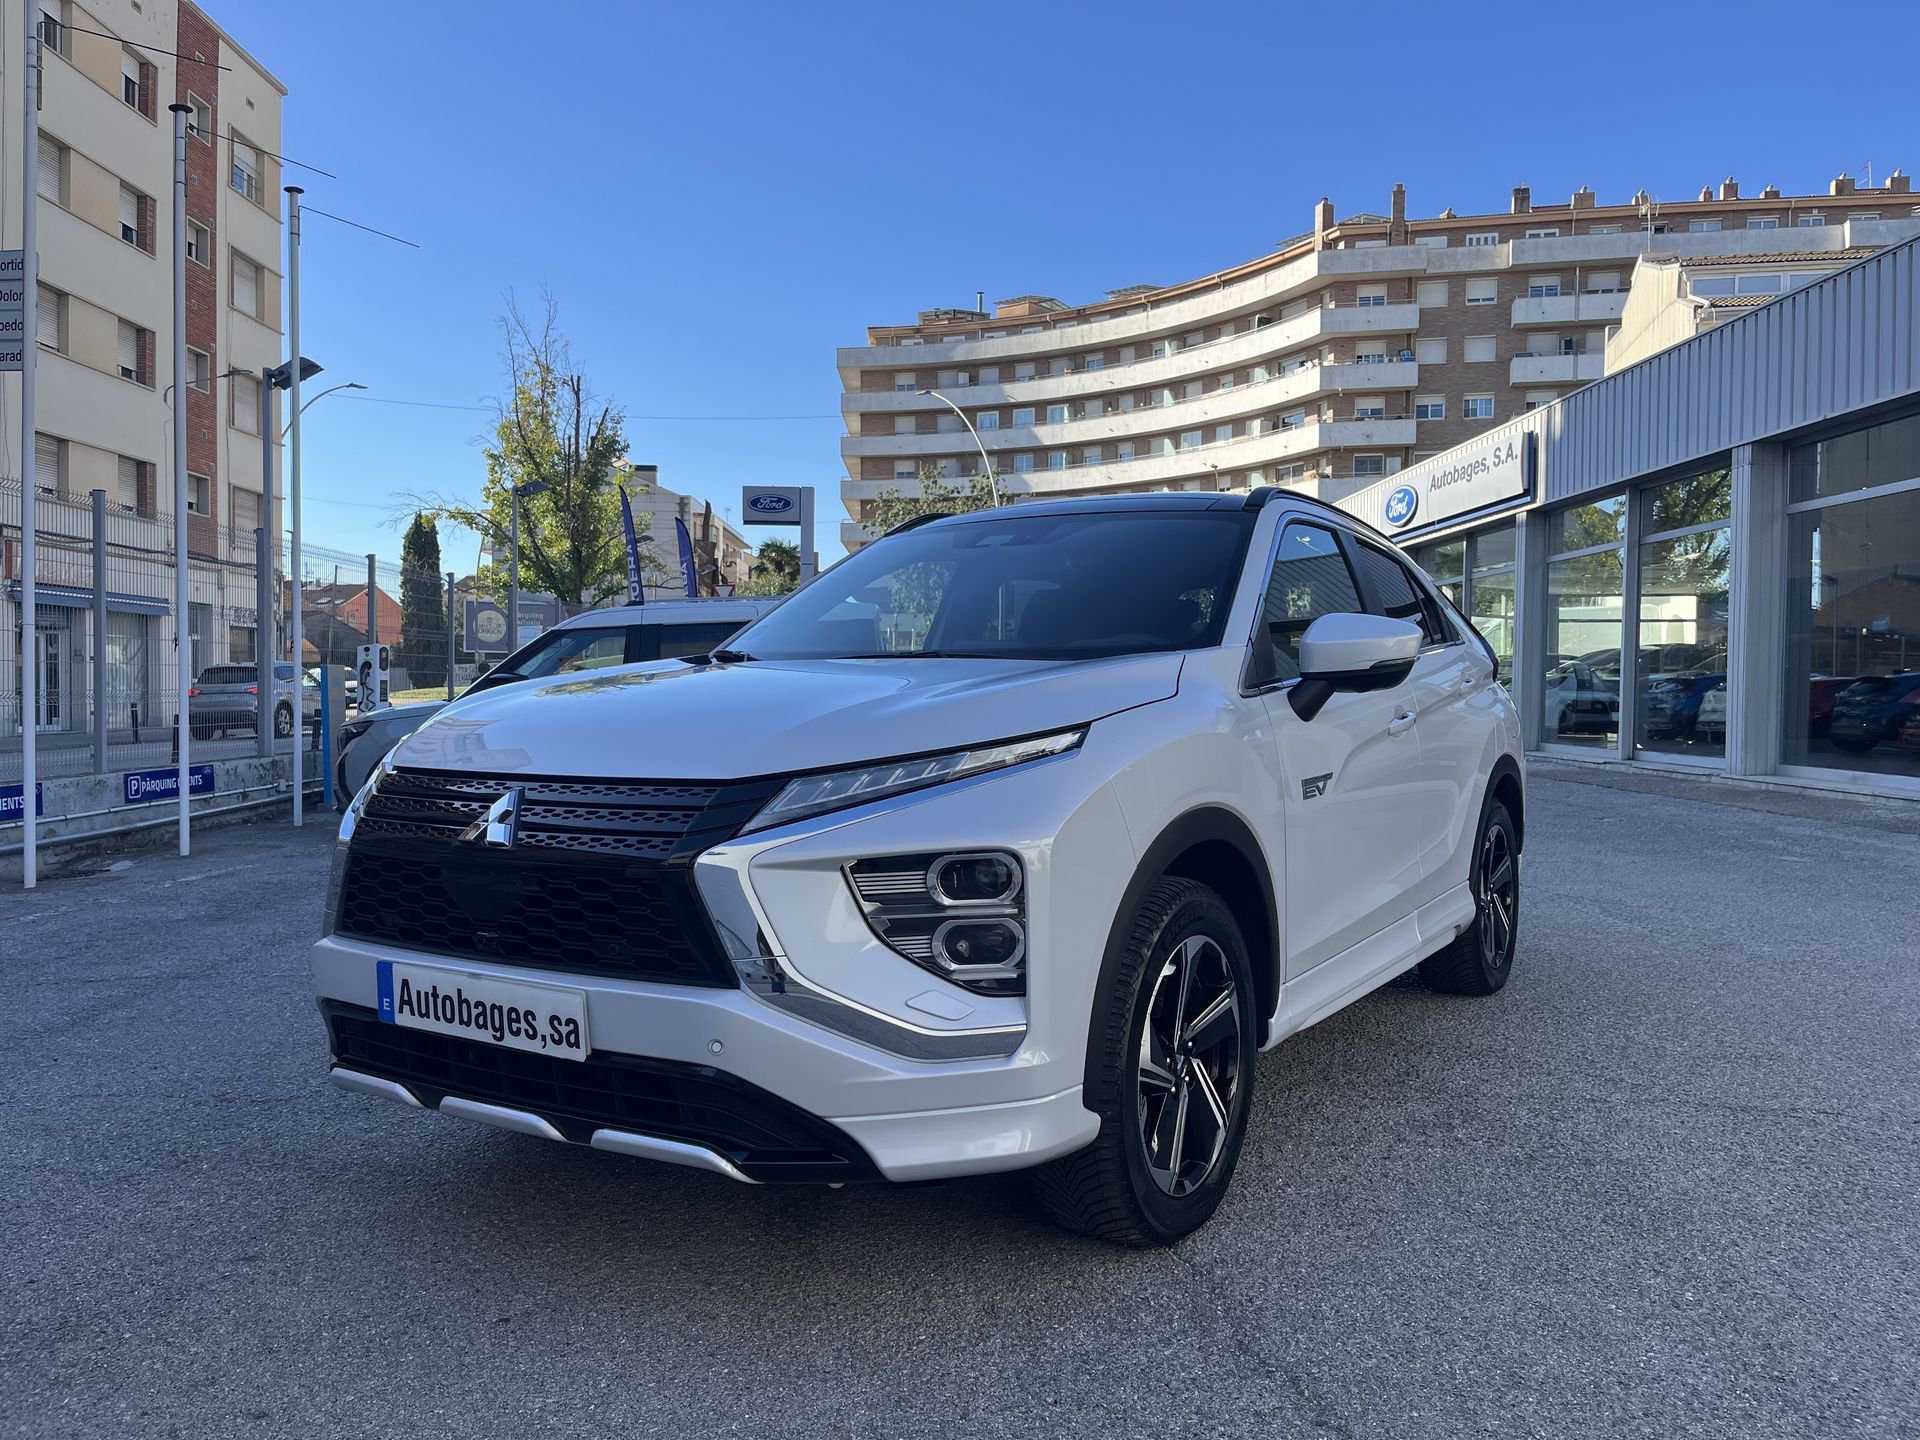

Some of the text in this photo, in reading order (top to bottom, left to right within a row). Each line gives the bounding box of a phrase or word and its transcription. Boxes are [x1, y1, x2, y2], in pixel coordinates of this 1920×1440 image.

[1430, 441, 1518, 492] Autobages, S.A.
[757, 496, 786, 509] Ford
[1388, 491, 1409, 519] Ford
[141, 777, 177, 793] PÀRQUING
[1301, 772, 1334, 801] EV
[383, 978, 582, 1050] E Autobages,sa
